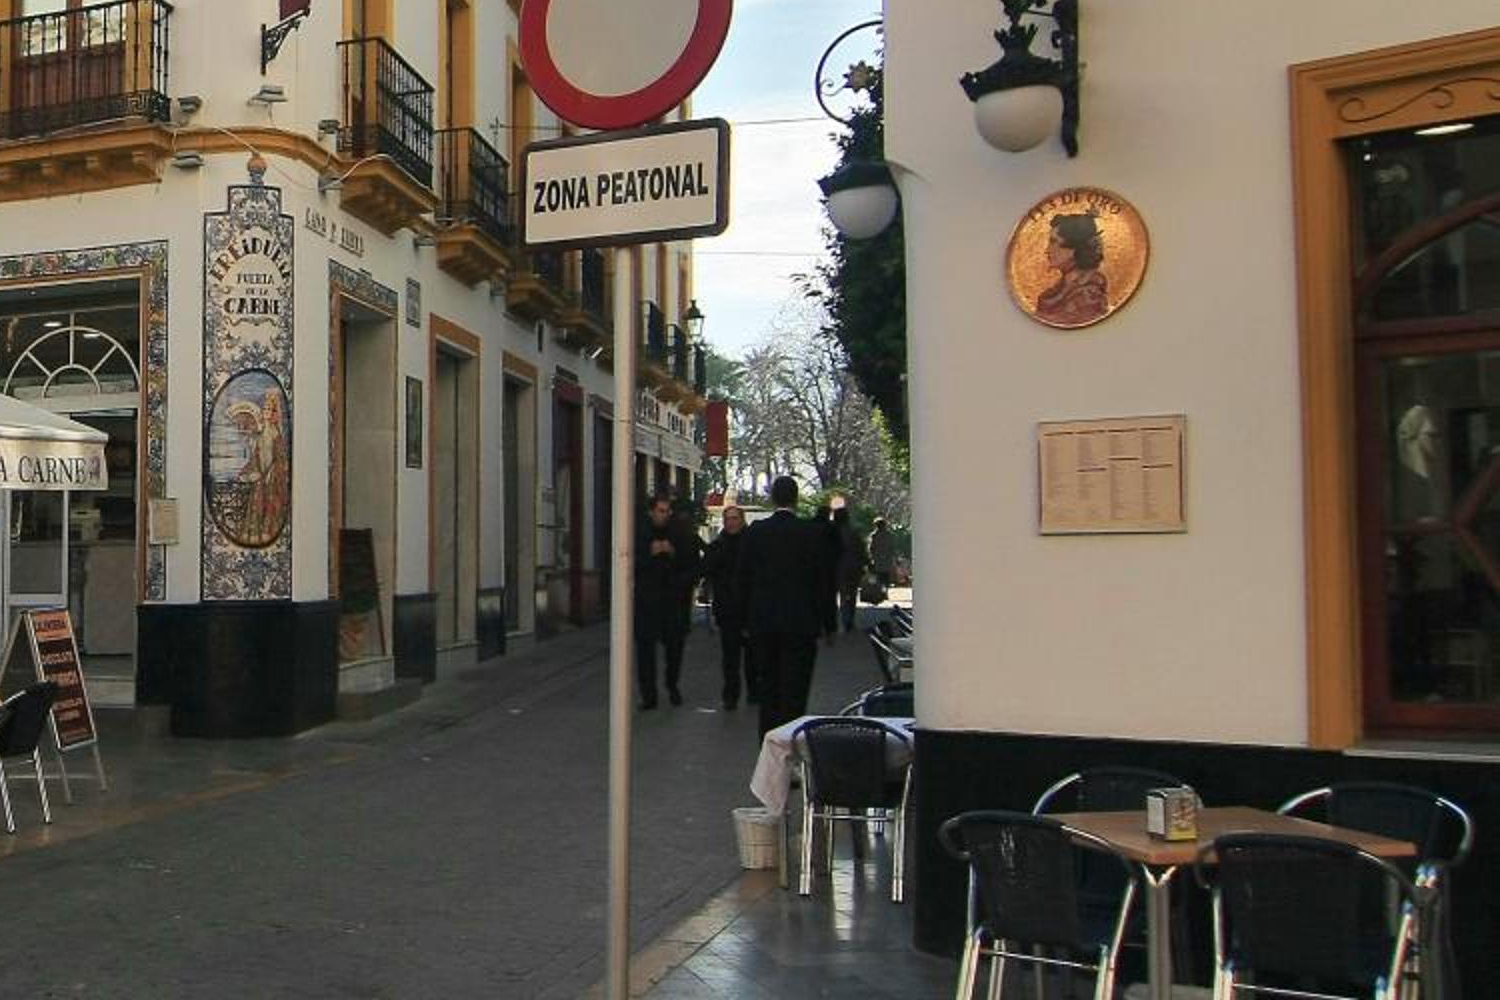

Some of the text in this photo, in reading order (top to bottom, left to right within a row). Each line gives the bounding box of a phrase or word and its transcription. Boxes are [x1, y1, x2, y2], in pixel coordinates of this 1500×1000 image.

[533, 162, 709, 214] ZONA PEATONAL
[223, 297, 280, 315] CARNE
[18, 454, 87, 484] CARNE
